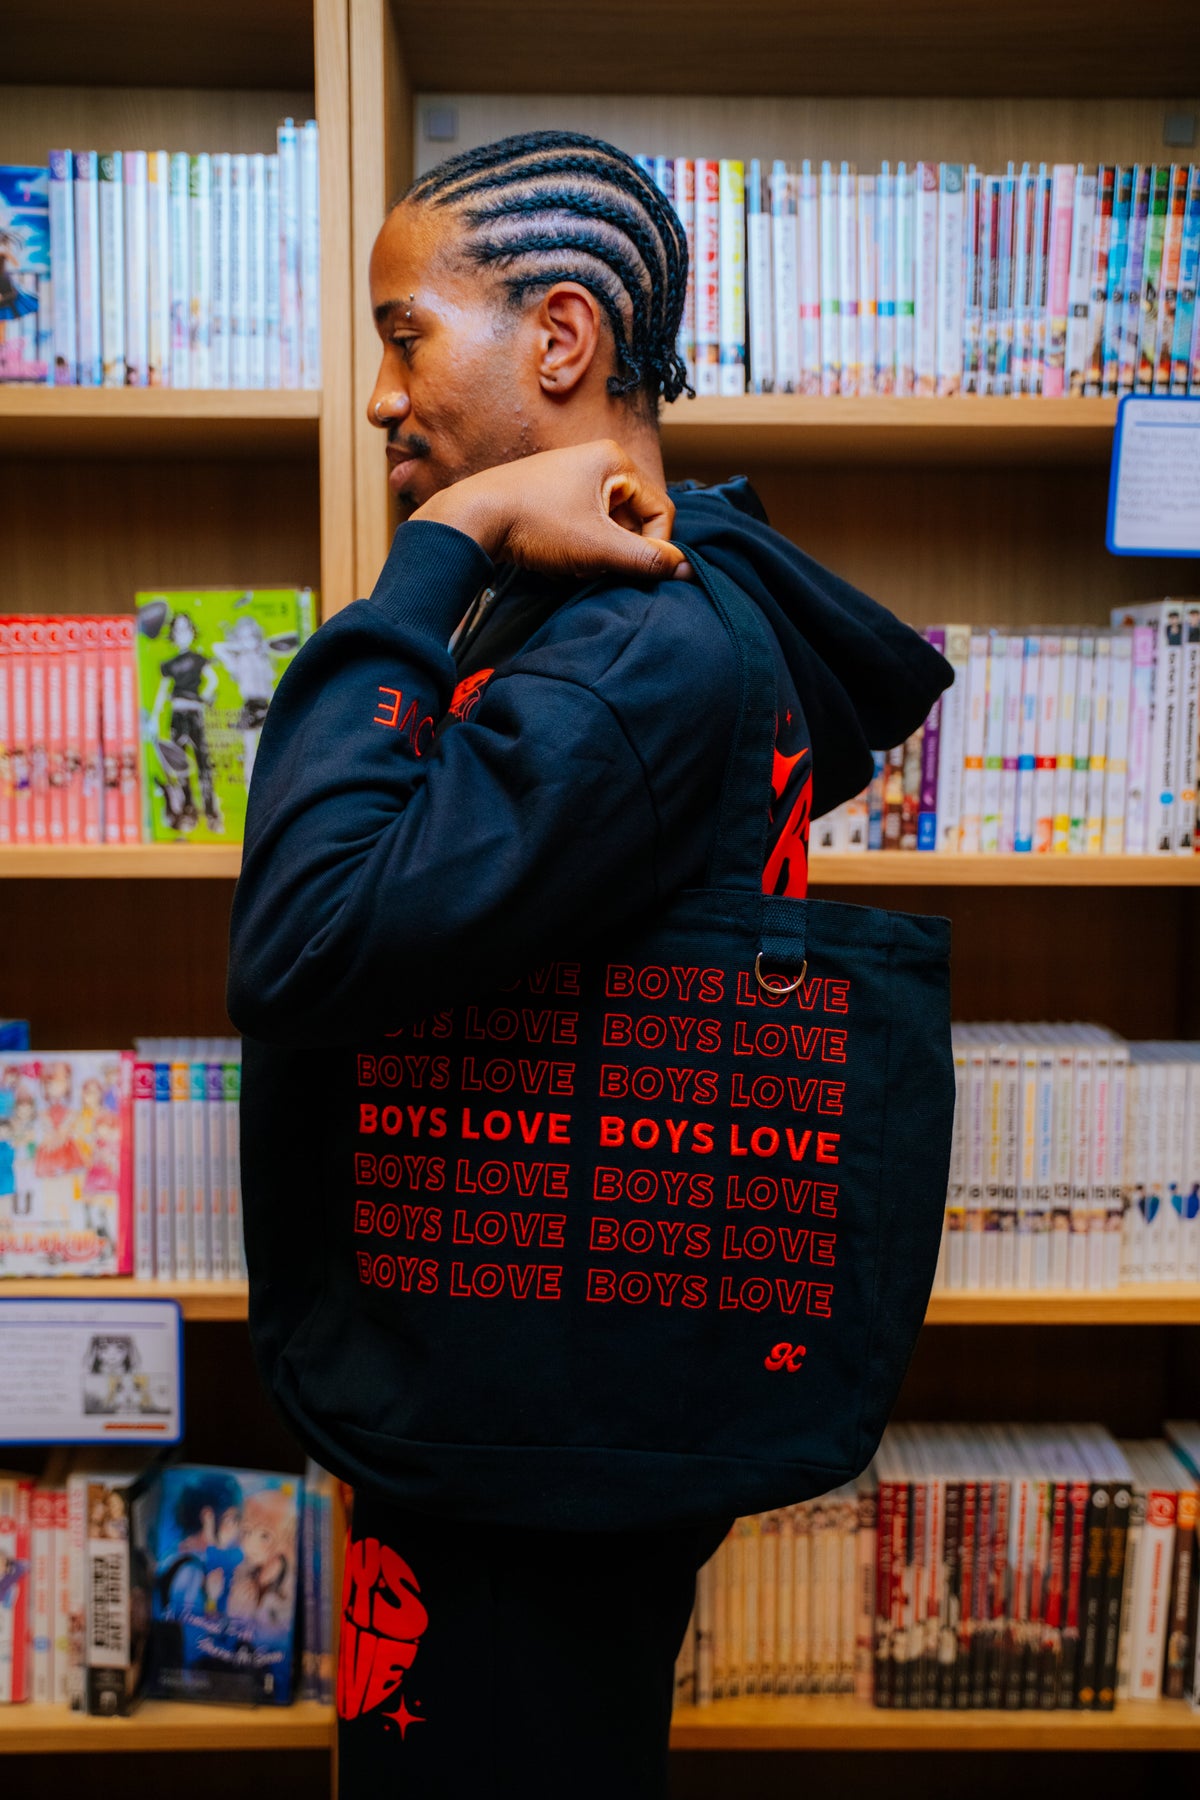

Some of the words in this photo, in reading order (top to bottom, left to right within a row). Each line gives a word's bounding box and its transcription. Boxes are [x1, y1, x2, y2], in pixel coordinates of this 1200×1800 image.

[374, 686, 434, 757] OVE
[605, 964, 725, 1003] BOYS
[736, 970, 851, 1015] LOVE
[464, 1006, 579, 1045] LOVE
[602, 1013, 722, 1053] BOYS
[732, 1021, 848, 1064] LOVE
[356, 1053, 451, 1090] BOYS
[460, 1056, 577, 1096] LOVE
[598, 1064, 719, 1105] BOYS
[730, 1072, 846, 1116] LOVE
[358, 1103, 448, 1138] BOYS
[460, 1107, 572, 1145] LOVE
[598, 1115, 715, 1155] BOYS
[729, 1123, 842, 1165] LOVE
[353, 1152, 447, 1192] BOYS
[455, 1158, 570, 1199] LOVE
[593, 1166, 714, 1208] BOYS
[725, 1175, 840, 1219] LOVE
[353, 1200, 443, 1244] BOYS
[452, 1209, 567, 1249] LOVE
[588, 1217, 712, 1259] BOYS
[721, 1225, 837, 1267] LOVE
[356, 1250, 440, 1295] BOYS
[449, 1261, 564, 1300] LOVE
[585, 1268, 708, 1309] BOYS
[718, 1276, 835, 1318] LOVE
